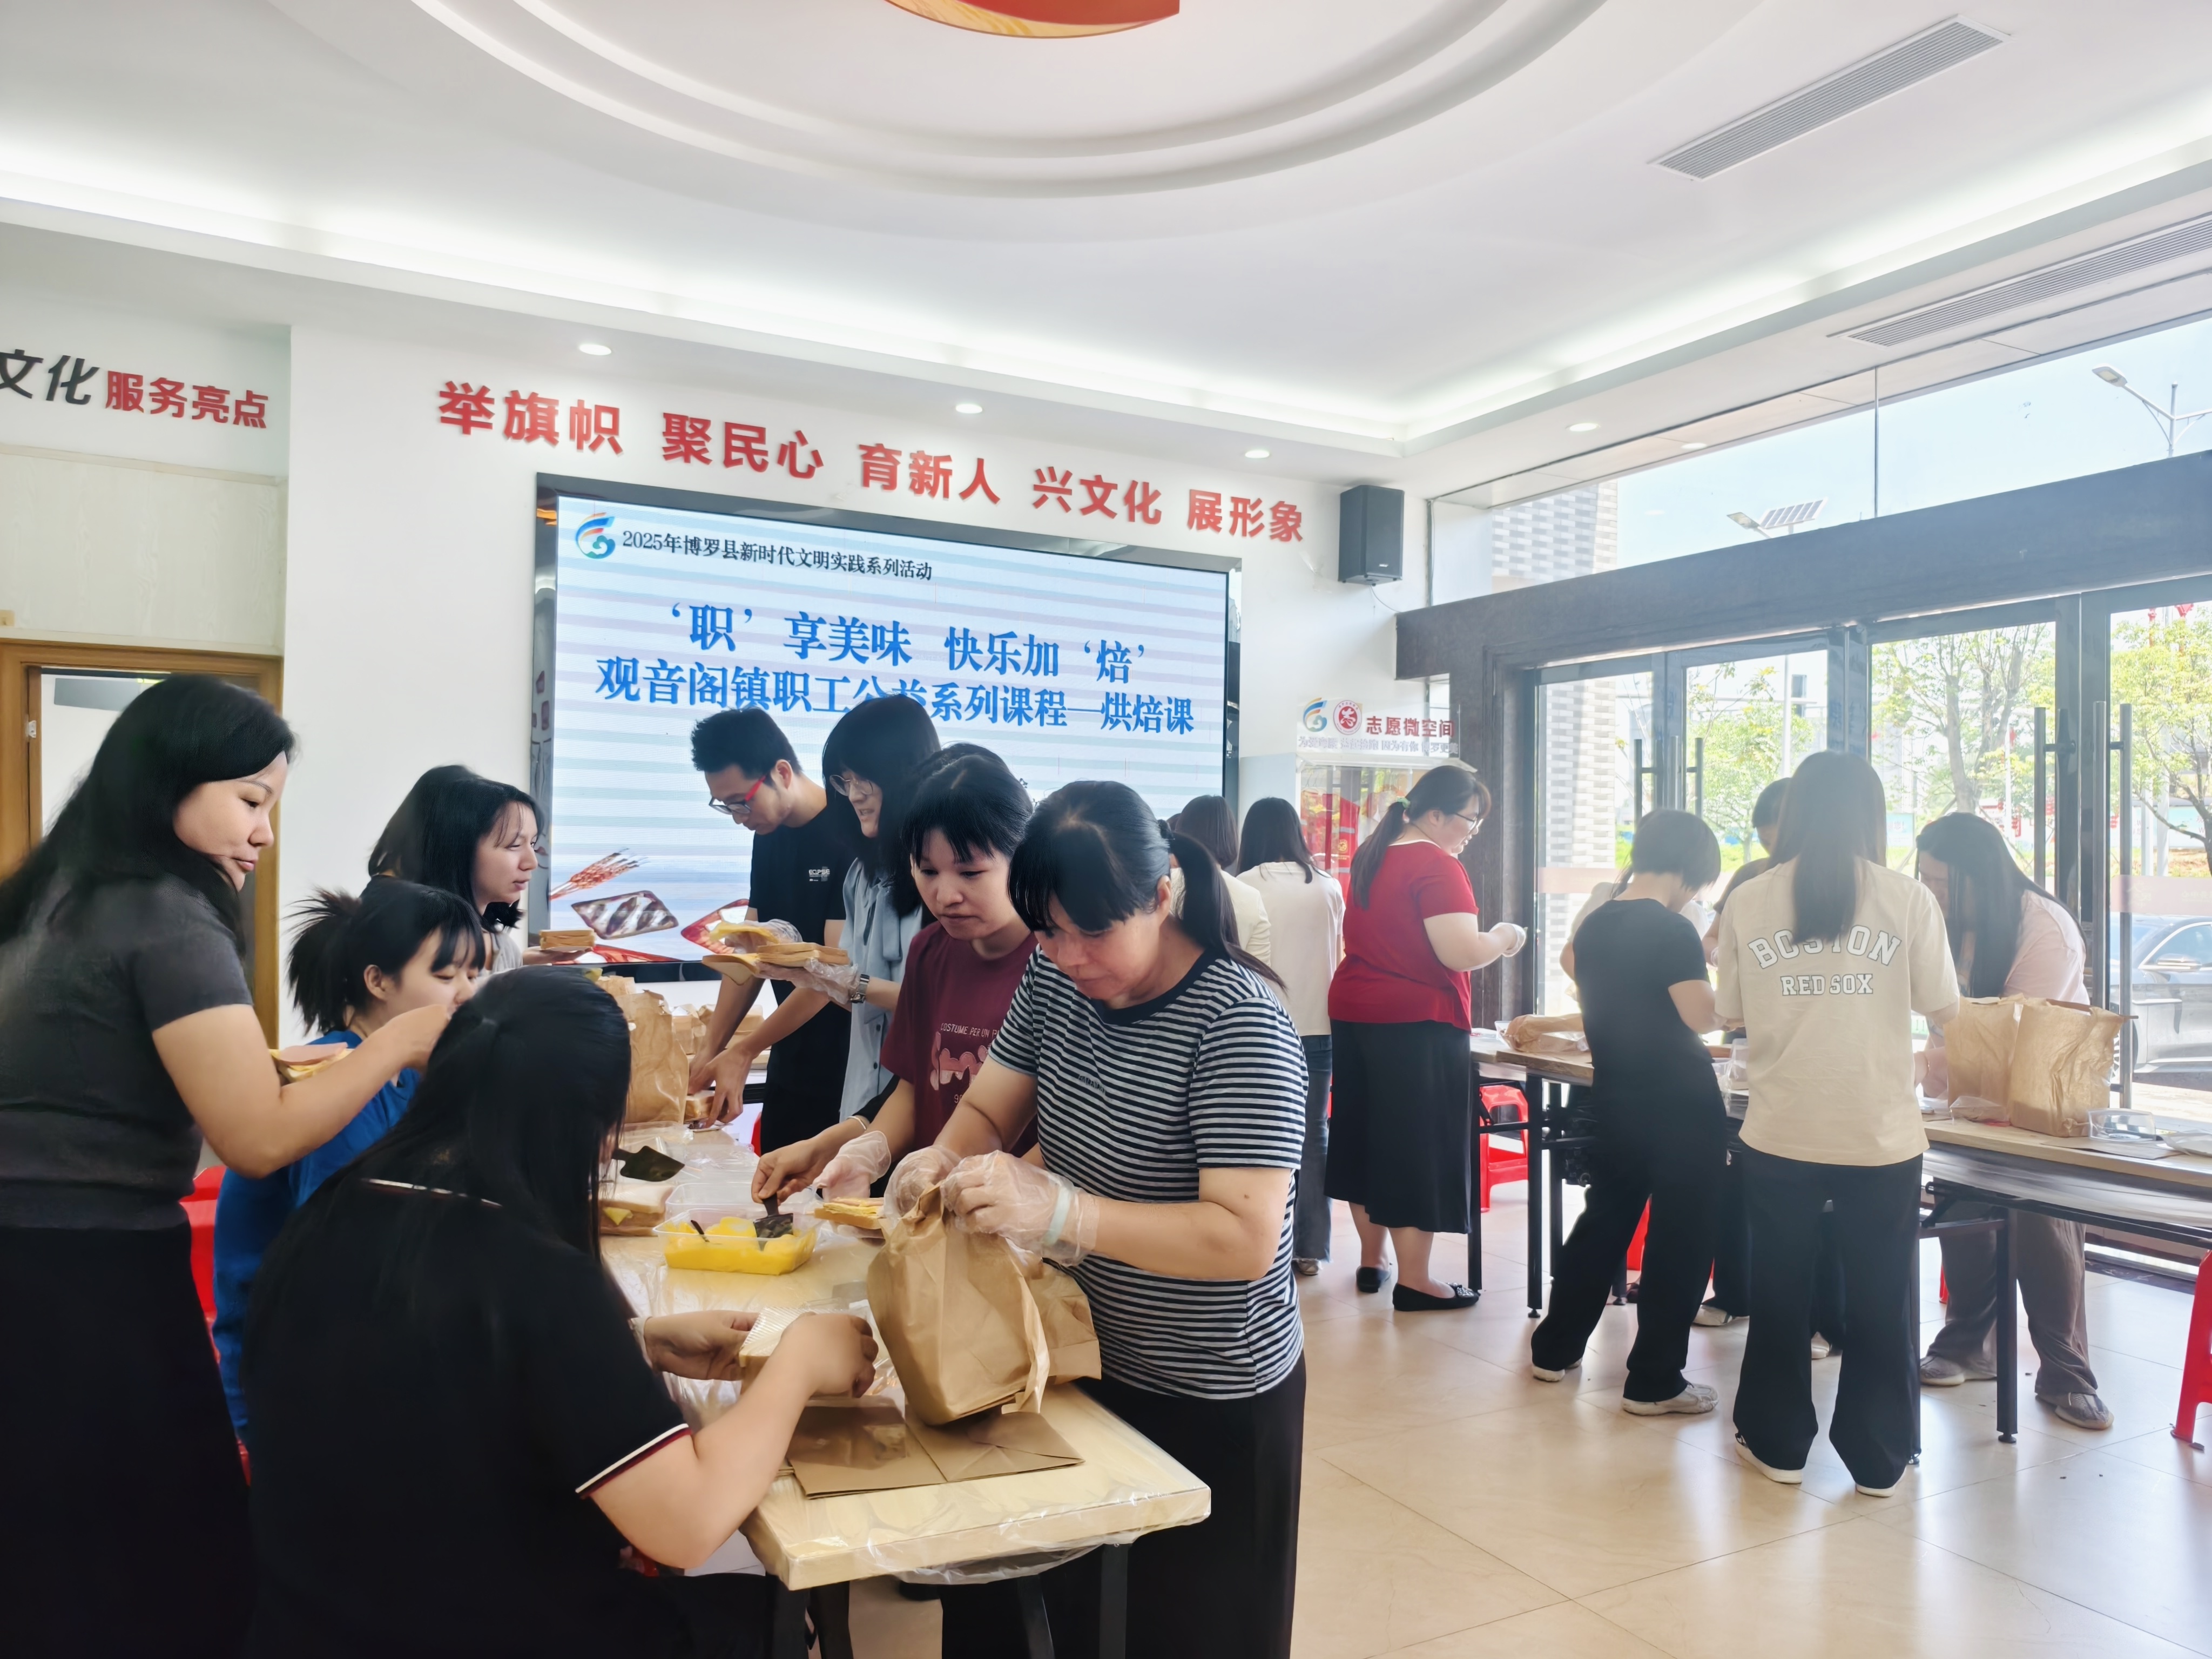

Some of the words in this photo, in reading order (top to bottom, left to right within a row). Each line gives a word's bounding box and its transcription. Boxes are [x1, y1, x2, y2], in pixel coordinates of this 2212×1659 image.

[0, 349, 100, 404] 文化
[105, 370, 268, 428] 服务亮点
[439, 381, 623, 455] 举旗帜
[662, 412, 824, 479] 聚民心
[858, 443, 1001, 504] 育新人
[1033, 466, 1162, 525] 兴文化
[1188, 489, 1303, 542] 展形象
[622, 530, 933, 581] 2025年博罗县新时代文明实践系列活动
[1366, 716, 1455, 738] 志愿微空间
[1381, 739, 1419, 752] 因为有你
[1780, 975, 1825, 996] RED
[1829, 974, 1873, 995] SOX
[981, 1028, 990, 1038] UN
